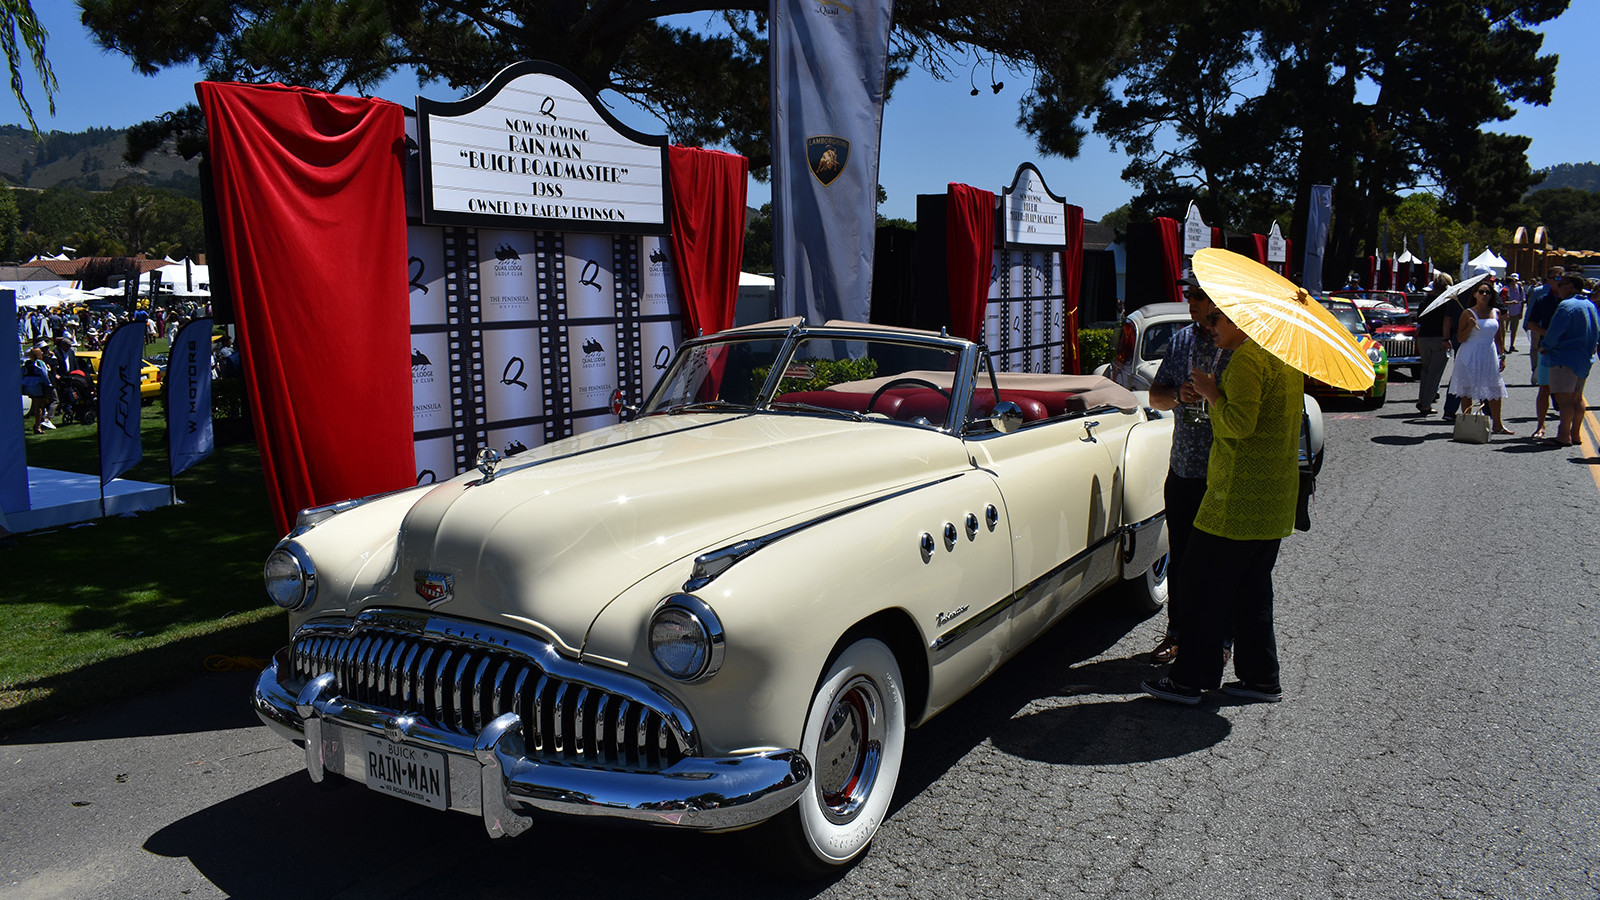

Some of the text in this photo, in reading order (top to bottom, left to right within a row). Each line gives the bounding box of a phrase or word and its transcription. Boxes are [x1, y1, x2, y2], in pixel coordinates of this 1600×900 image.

[820, 6, 839, 17] Quail
[539, 96, 557, 121] Q
[506, 118, 590, 142] NOW SHOWING
[509, 135, 581, 159] RAIN MAN
[531, 181, 563, 198] 1988
[468, 198, 625, 221] OWNED BY BARRY LEVINSON
[578, 259, 603, 293] Q
[499, 356, 528, 391] Q
[188, 340, 198, 435] W MOTORS
[388, 743, 415, 760] BUICK
[393, 785, 425, 801] ROADMASTER
